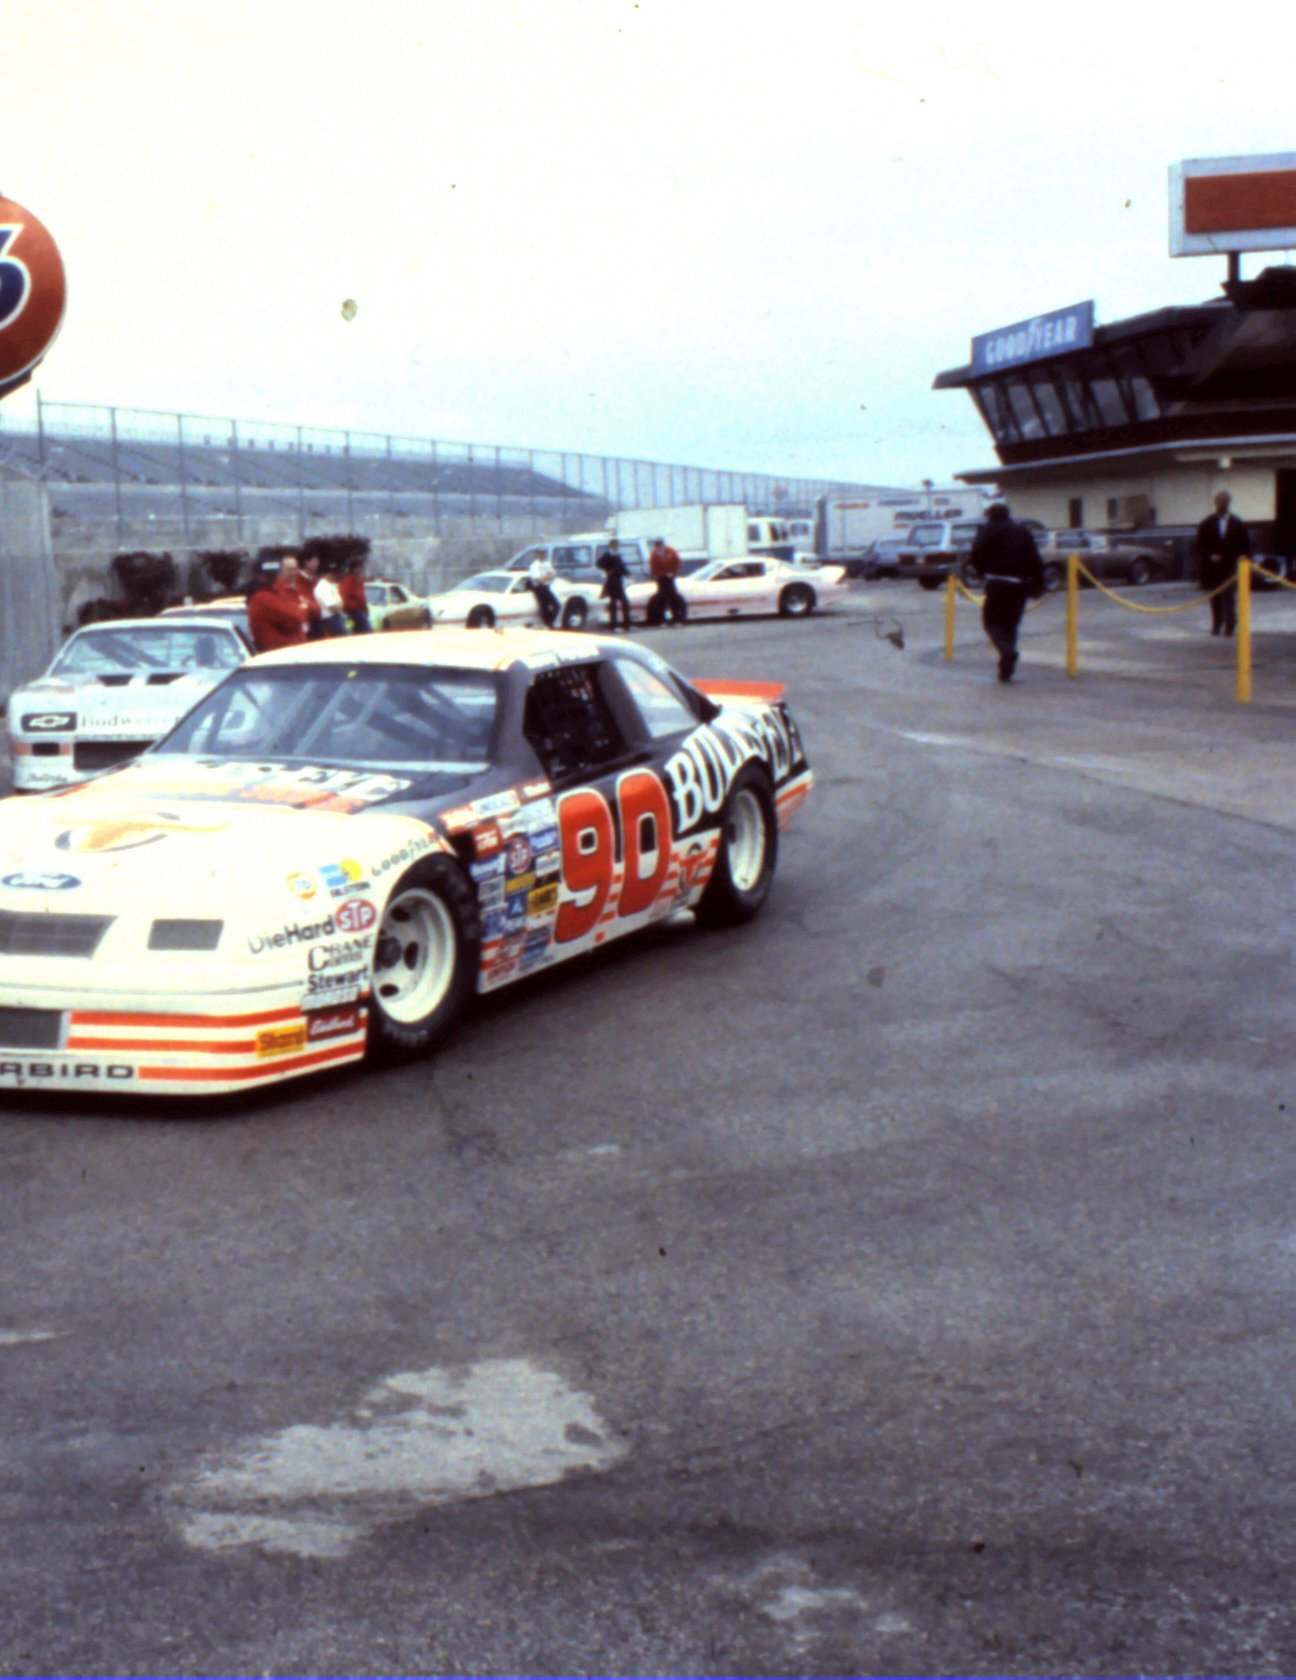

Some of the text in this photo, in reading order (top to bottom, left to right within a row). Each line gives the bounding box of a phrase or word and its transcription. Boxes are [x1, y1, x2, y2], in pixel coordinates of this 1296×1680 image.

[984, 316, 1078, 366] GOODYEAR
[554, 767, 672, 944] 90
[247, 914, 336, 955] DieHard
[338, 900, 373, 931] STP
[307, 964, 368, 992] Stewart
